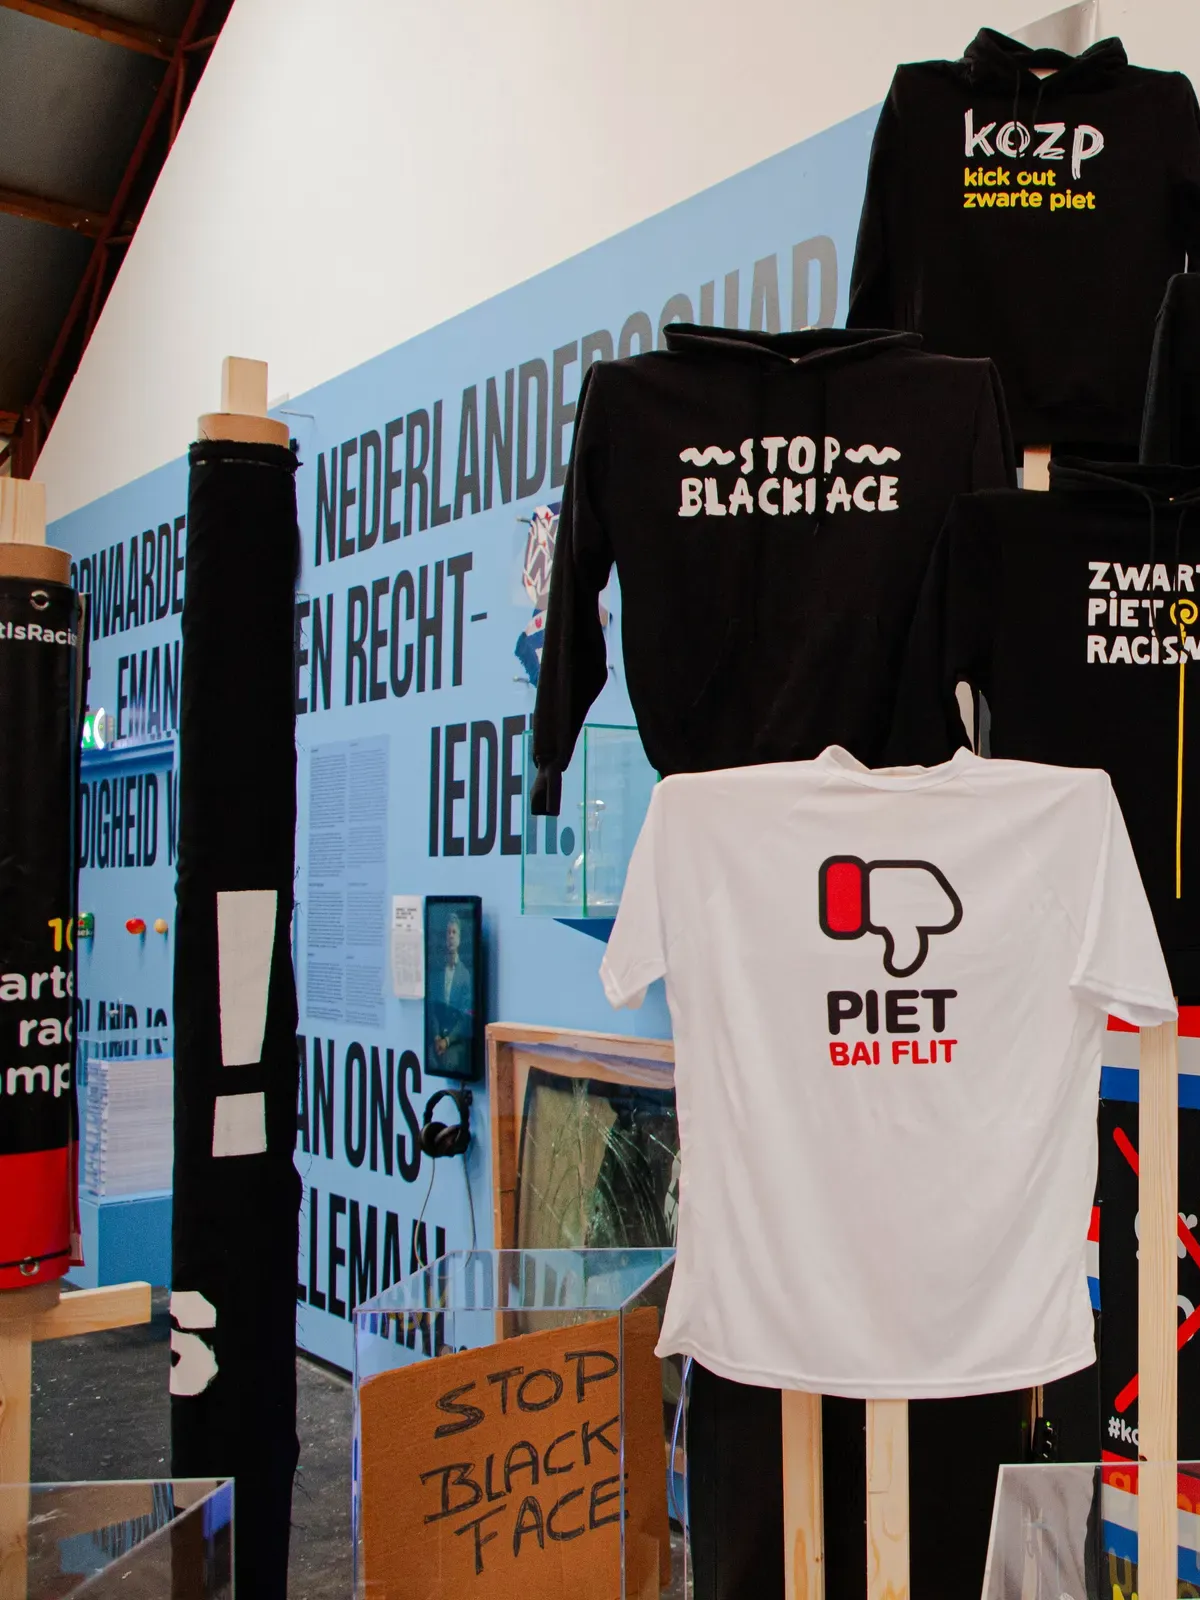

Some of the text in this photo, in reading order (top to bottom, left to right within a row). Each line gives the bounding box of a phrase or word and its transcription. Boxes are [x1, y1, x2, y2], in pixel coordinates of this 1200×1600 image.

[963, 189, 1096, 212] zwarte piet
[964, 167, 1056, 187] kick out
[740, 436, 841, 475] STOP
[345, 551, 488, 707] RECHT-
[827, 989, 958, 1035] PIET
[829, 1039, 958, 1066] BAI FLIT
[344, 1041, 423, 1183] ONS
[433, 1350, 619, 1439] STOP
[419, 1416, 620, 1524] BLACK
[454, 1473, 629, 1576] FACE
